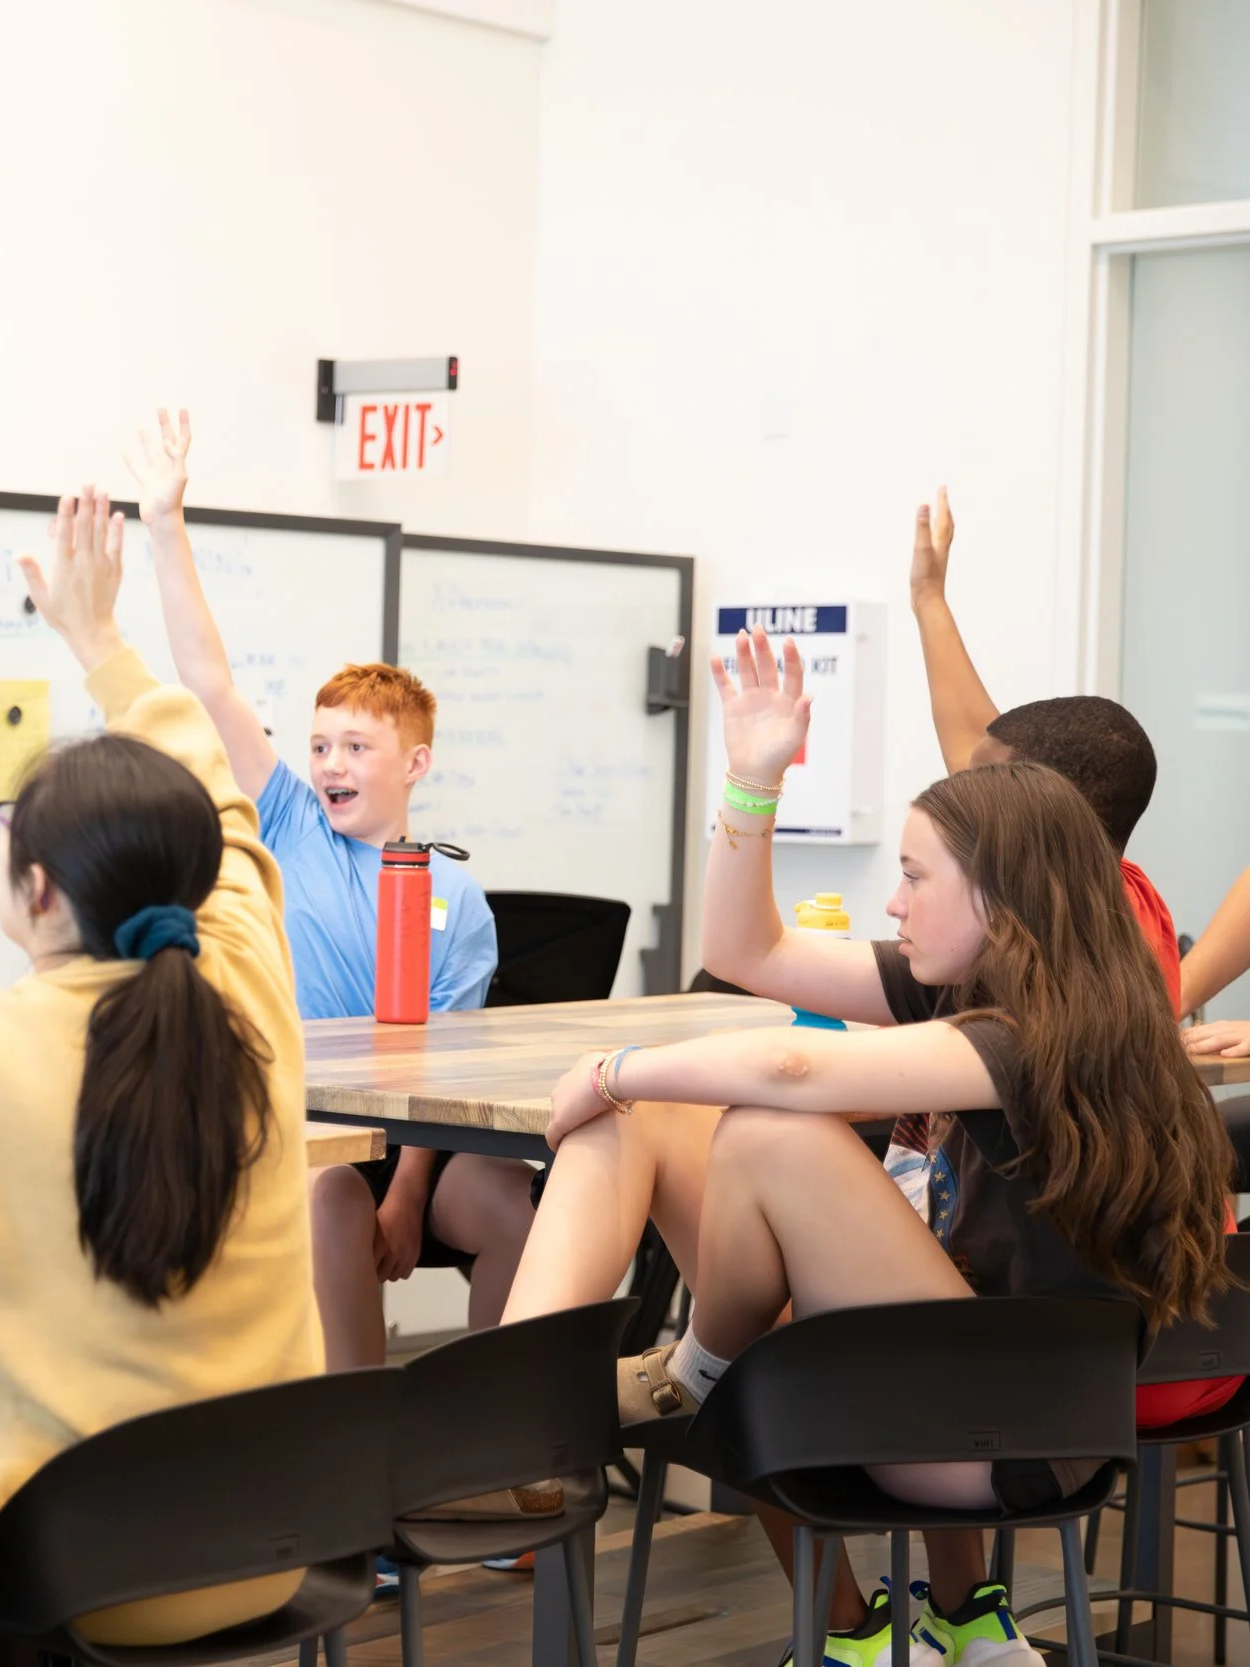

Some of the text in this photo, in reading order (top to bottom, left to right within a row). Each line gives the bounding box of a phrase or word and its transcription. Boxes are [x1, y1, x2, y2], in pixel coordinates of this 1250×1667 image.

[358, 403, 432, 470] EXIT
[745, 607, 817, 634] ULINE
[811, 656, 838, 675] KIT
